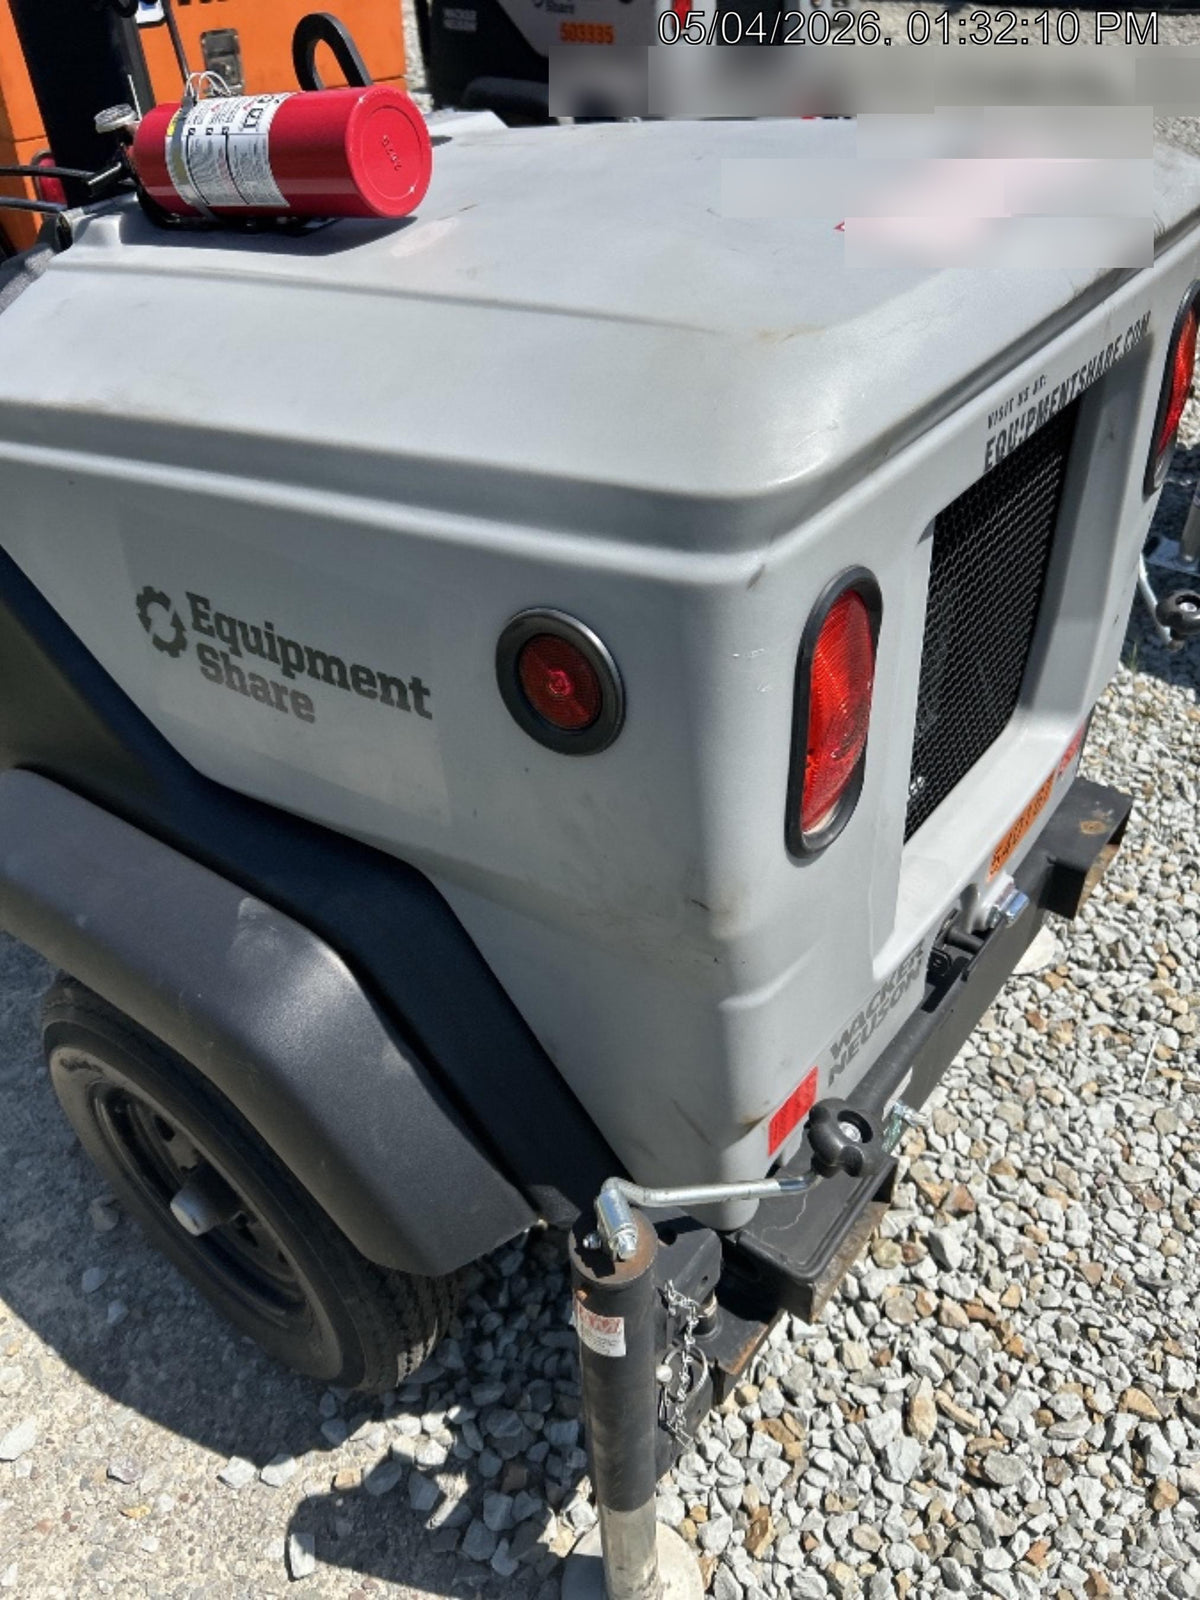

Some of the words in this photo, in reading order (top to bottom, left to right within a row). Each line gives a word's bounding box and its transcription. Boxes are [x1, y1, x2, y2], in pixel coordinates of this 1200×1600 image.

[984, 310, 1152, 472] EQUIPMENTSHARE.COM
[987, 397, 1014, 429] VISIT
[185, 591, 433, 720] Equipment
[196, 643, 316, 724] Share
[828, 957, 922, 1088] NEUSON
[829, 938, 925, 1060] WACKER
